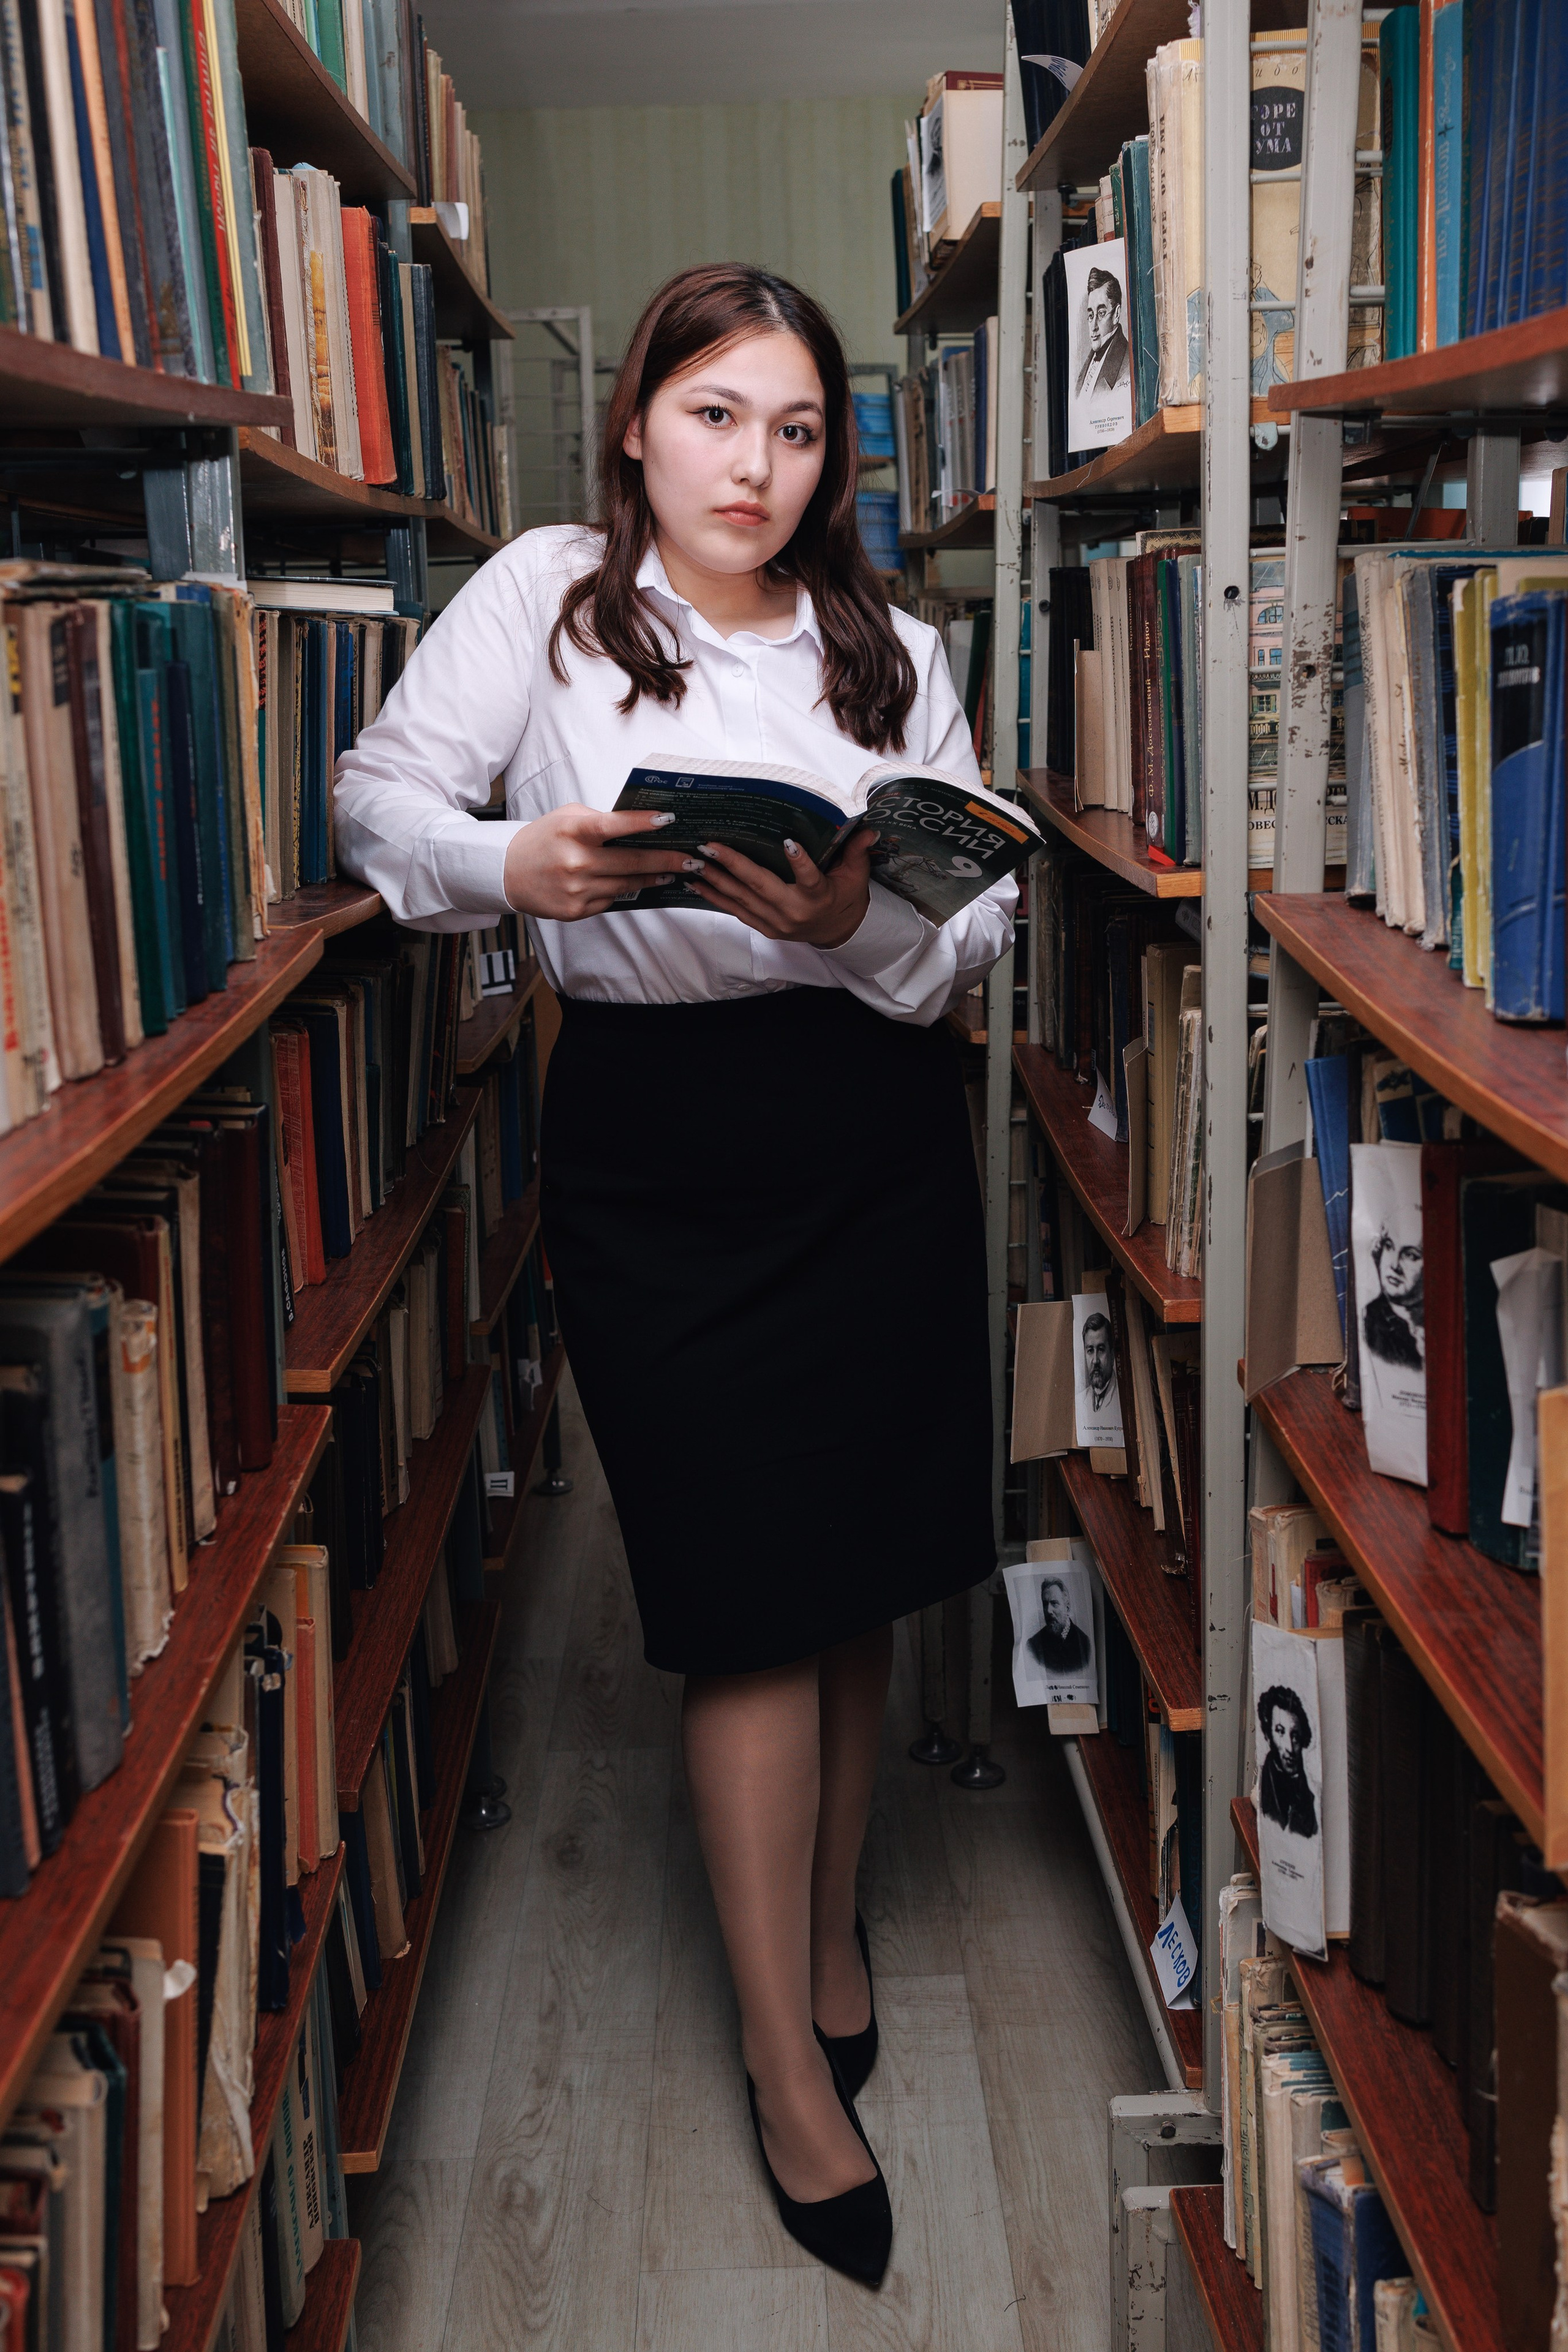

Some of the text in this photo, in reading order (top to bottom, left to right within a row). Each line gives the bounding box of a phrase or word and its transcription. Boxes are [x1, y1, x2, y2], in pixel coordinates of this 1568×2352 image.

[1255, 137, 1292, 154] УМА
[1260, 121, 1286, 137] ОТ
[1160, 169, 1167, 194] ОТ
[1145, 677, 1155, 756] Достоевский
[1248, 790, 1276, 815] М.Д
[862, 809, 995, 860] ОССИИ
[1248, 820, 1276, 830] ОВЕ
[944, 856, 982, 878] 9
[281, 1248, 294, 1322] В.САФОНОВ
[1157, 1921, 1191, 1988] ЛЕСКОВ
[303, 2139, 314, 2230] АЛЕКСАНДР
[307, 2130, 320, 2225] ПОПОВСКИЙ
